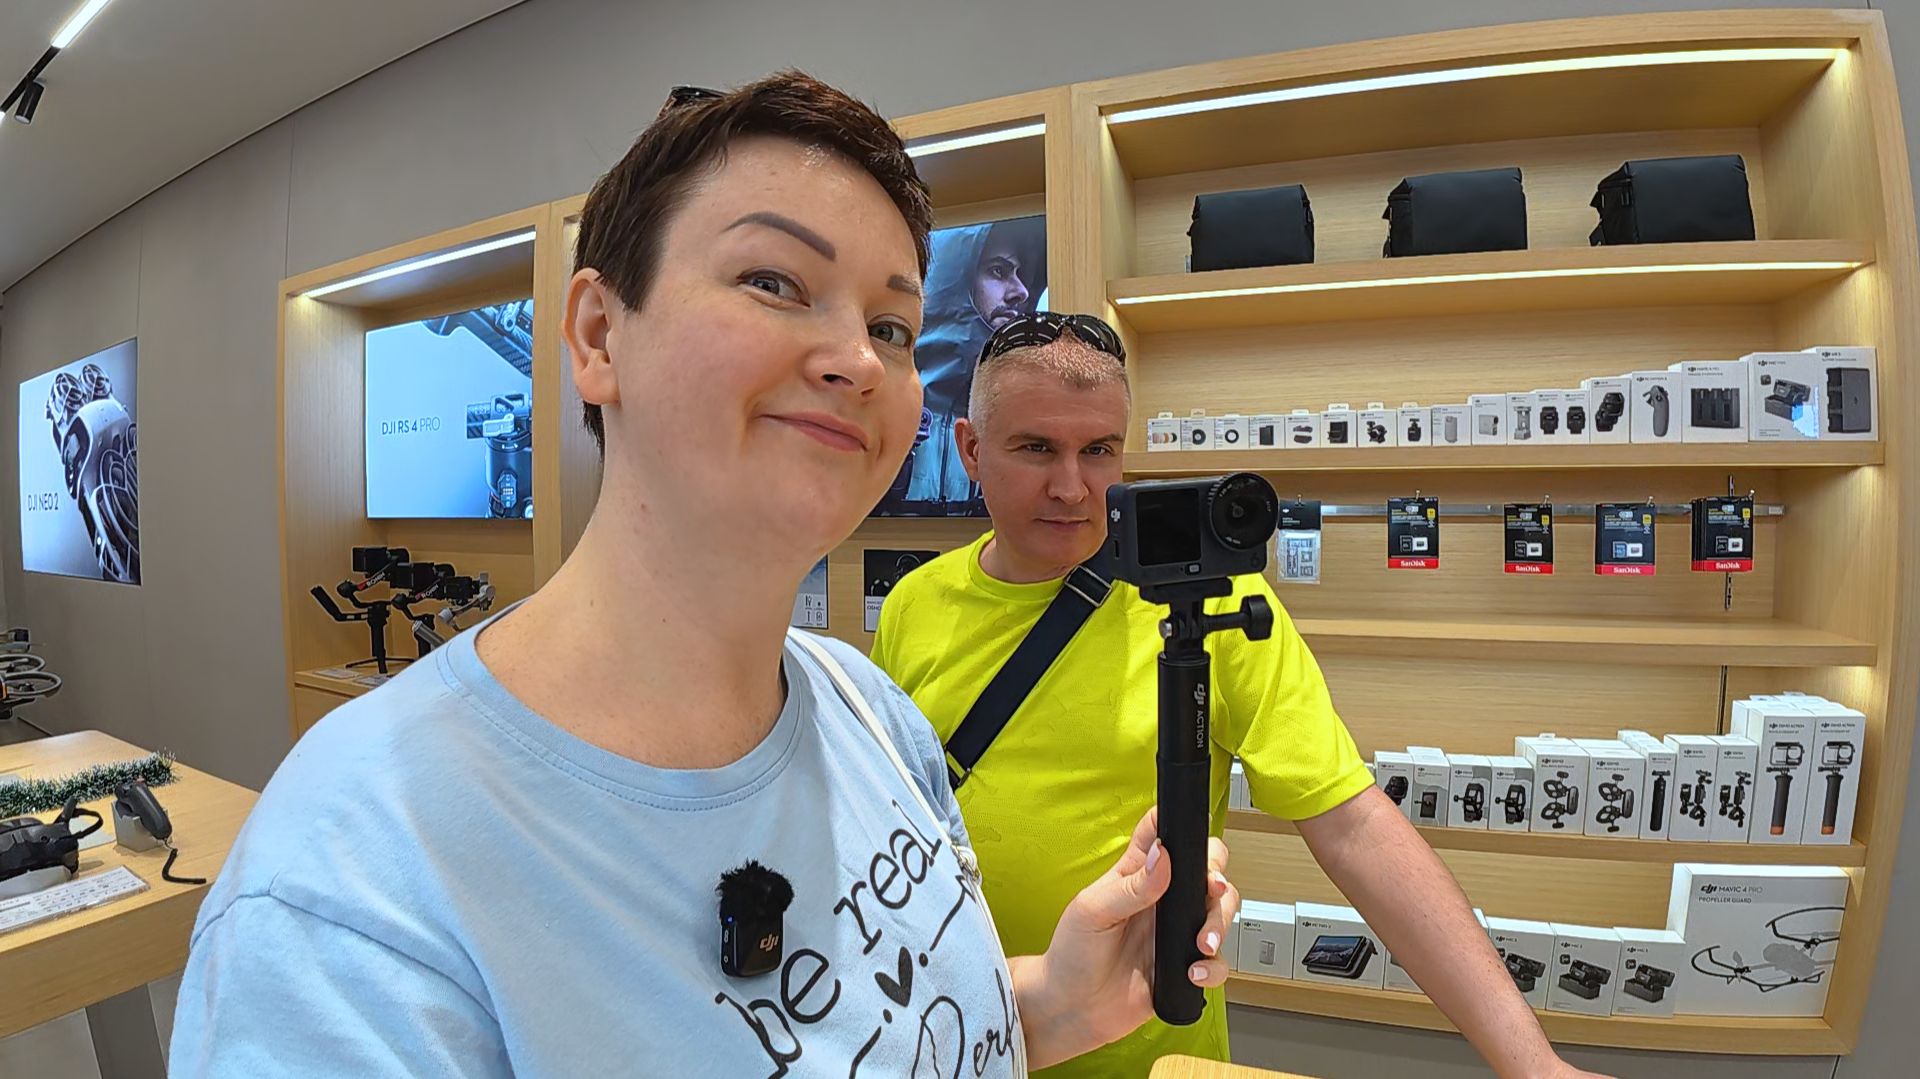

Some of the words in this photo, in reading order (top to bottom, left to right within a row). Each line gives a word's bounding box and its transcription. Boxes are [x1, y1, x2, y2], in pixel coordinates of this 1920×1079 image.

[381, 421, 396, 435] DJI
[397, 419, 410, 433] RS
[411, 419, 418, 432] 4
[419, 416, 441, 432] PRO
[27, 494, 38, 511] DJI
[39, 492, 53, 511] NEO
[54, 492, 59, 511] 2
[1400, 559, 1426, 567] SanDisk
[1514, 565, 1541, 573] SanDisk
[1715, 561, 1741, 569] SanDisk
[1196, 710, 1204, 748] ACTION
[714, 948, 842, 1079] be
[833, 798, 943, 955] real
